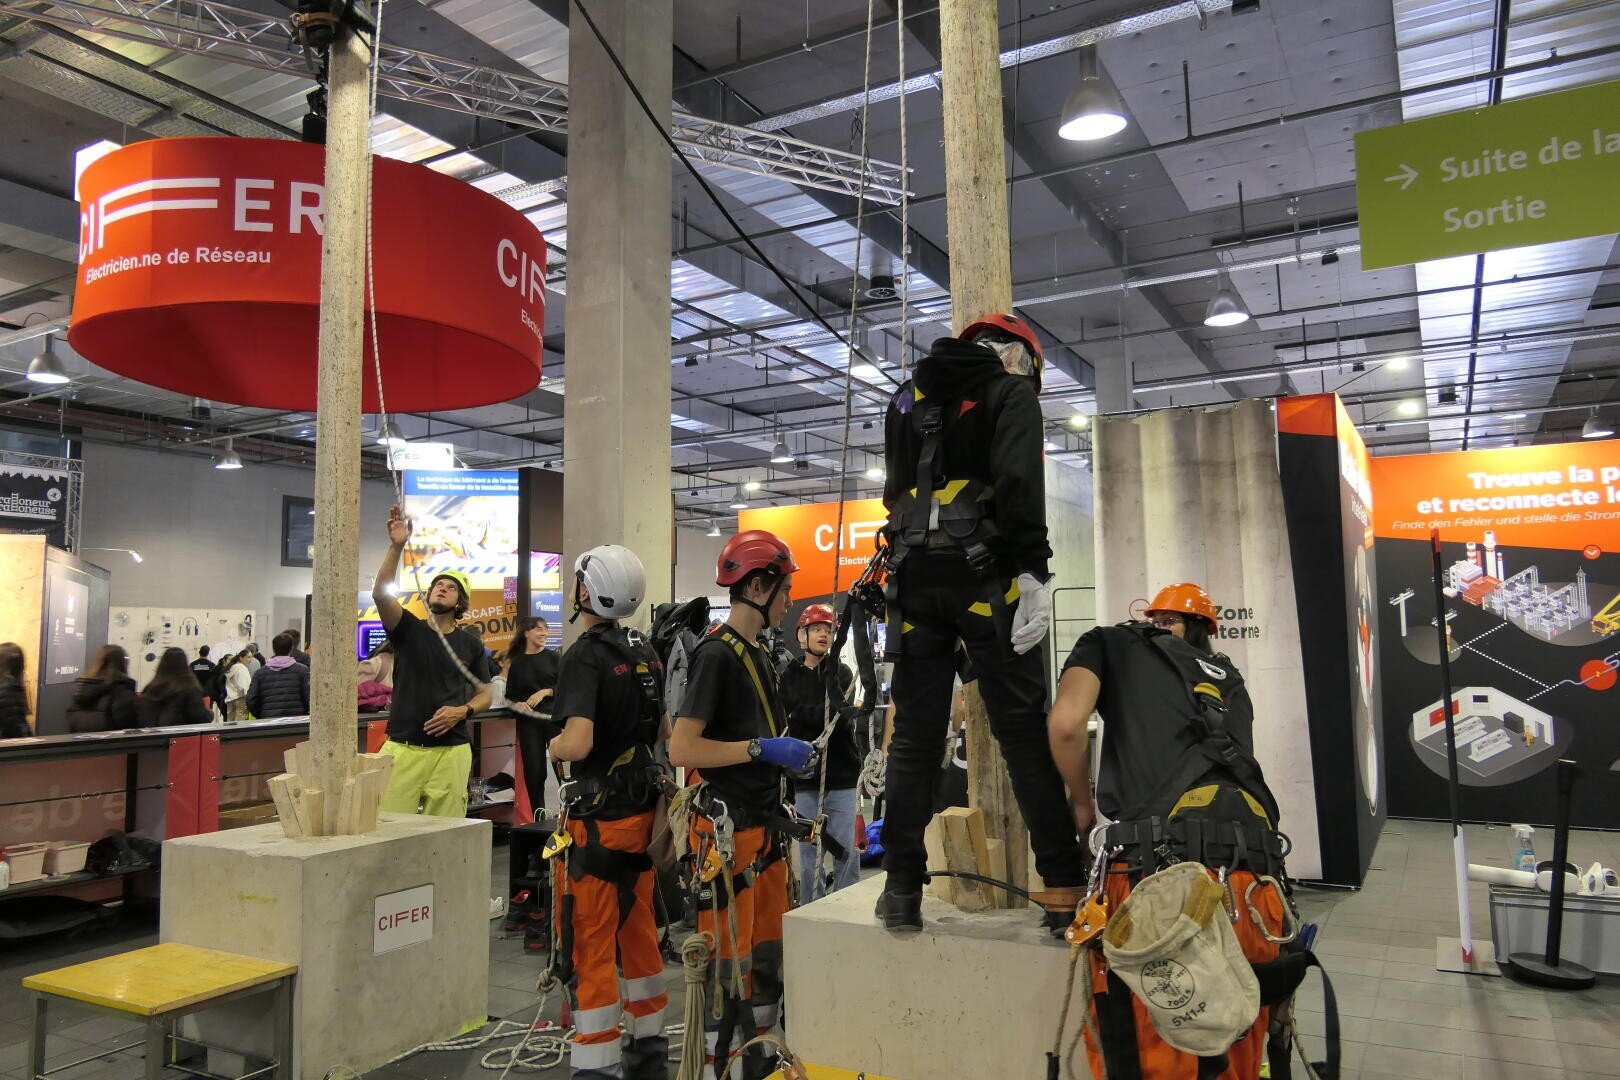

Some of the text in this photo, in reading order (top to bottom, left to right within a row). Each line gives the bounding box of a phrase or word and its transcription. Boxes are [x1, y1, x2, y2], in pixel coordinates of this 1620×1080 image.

[1440, 129, 1620, 182] Suite de la
[1443, 196, 1546, 232] Sortie
[86, 247, 271, 285] Electricien.ne de Réseau
[1468, 470, 1562, 490] Trouve
[1568, 465, 1594, 484] la
[1417, 496, 1444, 514] et
[1449, 489, 1600, 513] reconnecte
[1392, 520, 1425, 530] Finde
[1428, 519, 1451, 529] den
[1454, 517, 1493, 527] Fehler
[1496, 515, 1521, 525] und
[1523, 513, 1557, 524] stelle
[1561, 512, 1581, 522] die
[1215, 605, 1254, 620] Zone
[1210, 625, 1260, 640] nterne
[378, 905, 430, 931] CIFER
